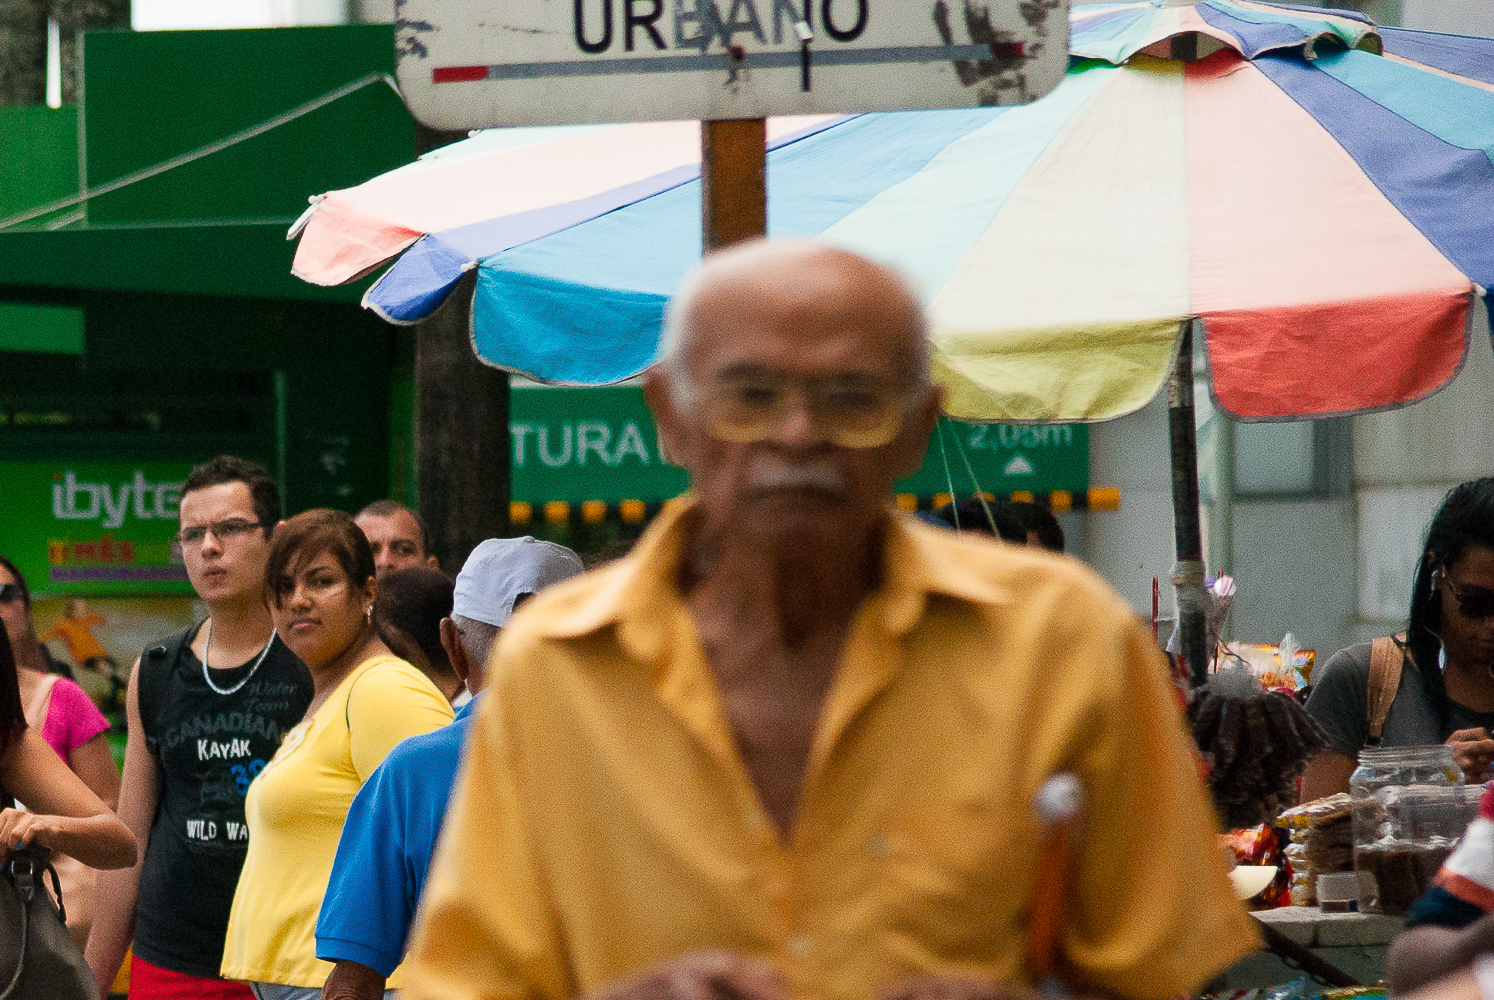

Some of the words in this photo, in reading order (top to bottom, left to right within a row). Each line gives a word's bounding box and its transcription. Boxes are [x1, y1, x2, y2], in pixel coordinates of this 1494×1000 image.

[573, 0, 869, 54] URBANO
[52, 470, 182, 528] ibyte
[196, 737, 252, 762] KAYAK
[186, 819, 218, 841] WILD
